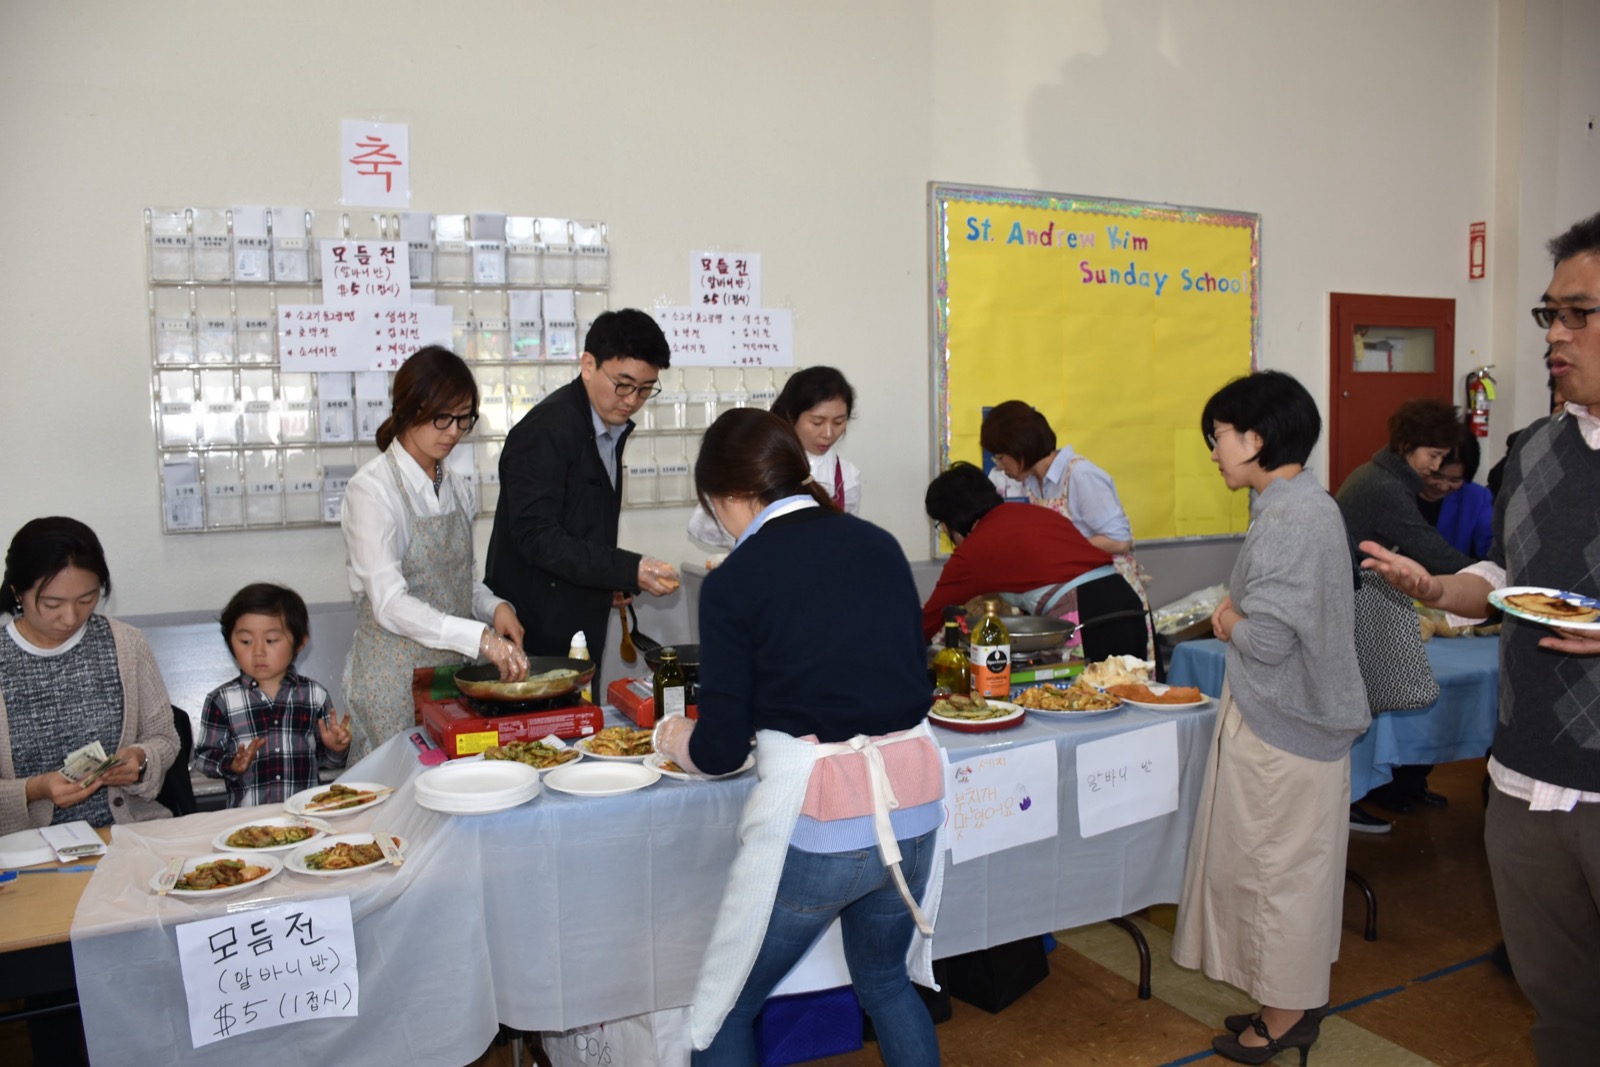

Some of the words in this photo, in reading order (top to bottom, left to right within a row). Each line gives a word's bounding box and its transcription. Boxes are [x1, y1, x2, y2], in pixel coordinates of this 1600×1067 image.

[349, 135, 402, 193] 축
[966, 217, 995, 242] St.
[1006, 222, 1095, 249] Andrew
[1107, 225, 1148, 251] Kim
[332, 245, 396, 266] 모듬전
[701, 258, 749, 276] 모듬전
[1079, 260, 1168, 296] Sunday
[1182, 268, 1250, 294] School
[1087, 766, 1127, 792] 알바니
[1141, 759, 1153, 773] 반
[208, 912, 325, 965] 모듬전
